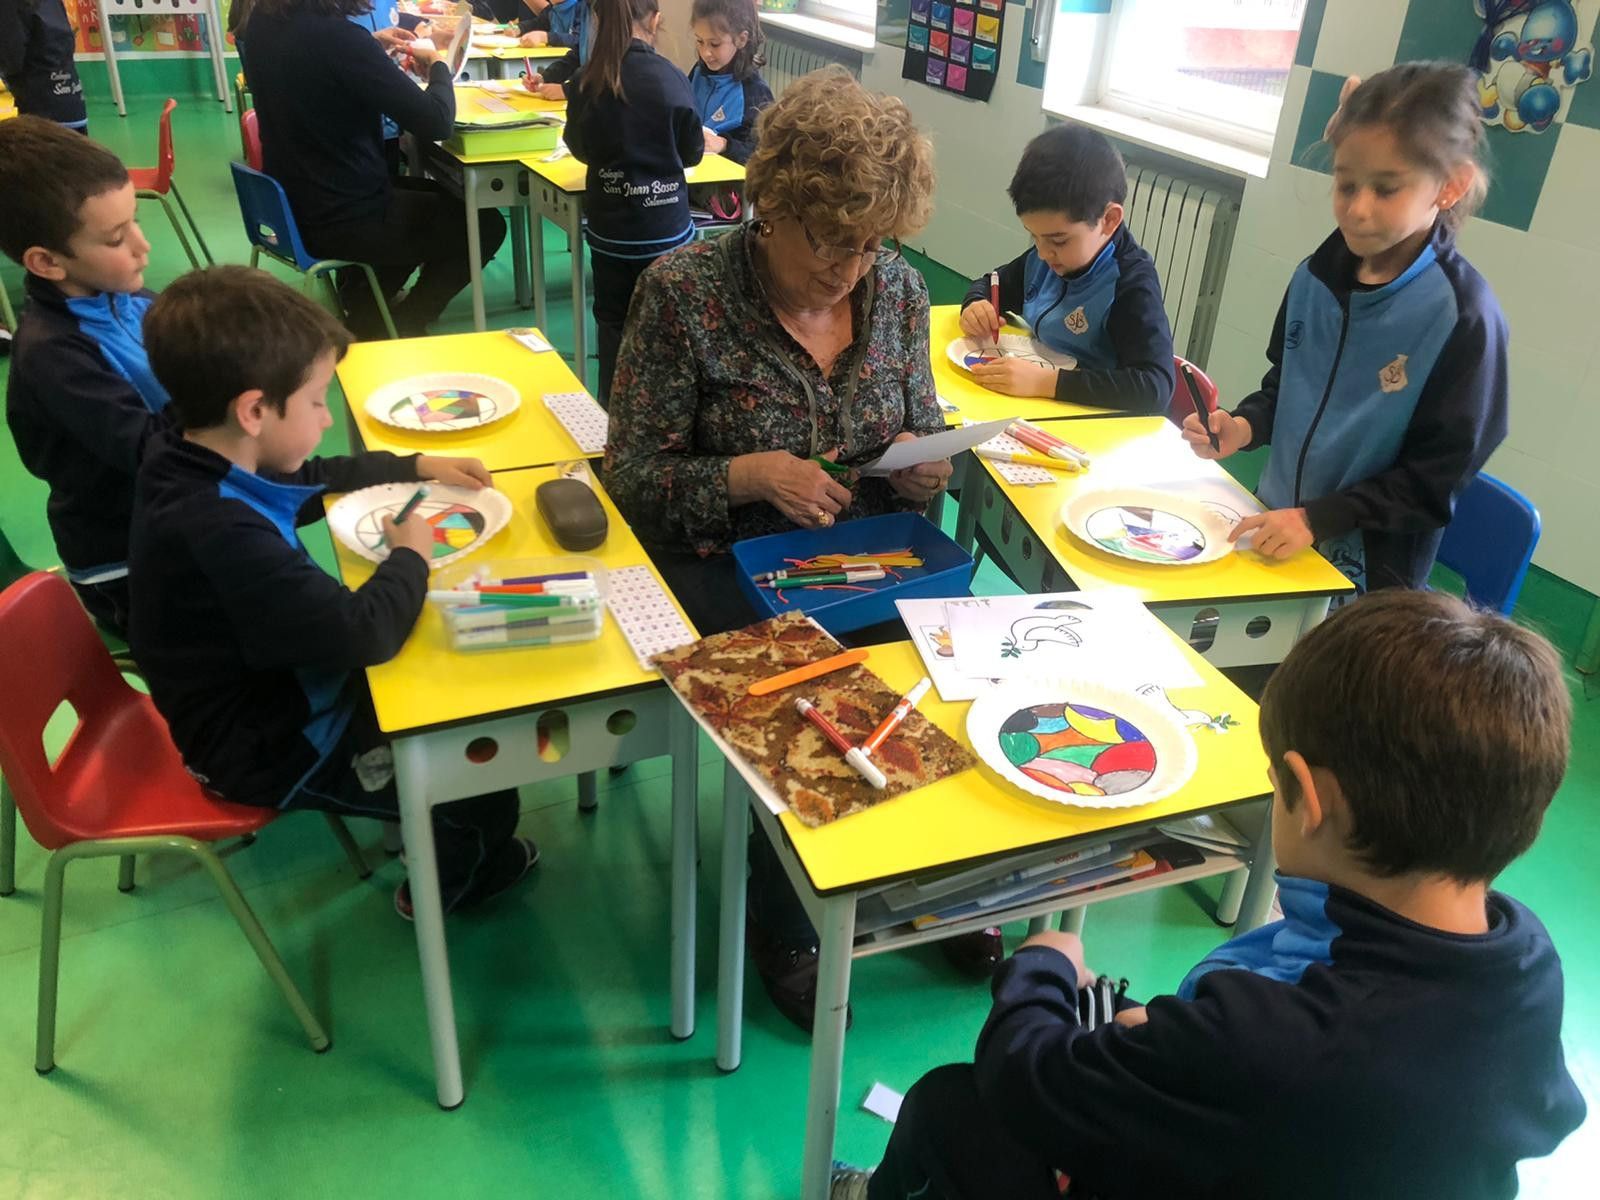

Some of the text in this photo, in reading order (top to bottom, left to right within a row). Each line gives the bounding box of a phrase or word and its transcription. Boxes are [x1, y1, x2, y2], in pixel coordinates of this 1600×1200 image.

[603, 180, 679, 197] San Juan Bosco
